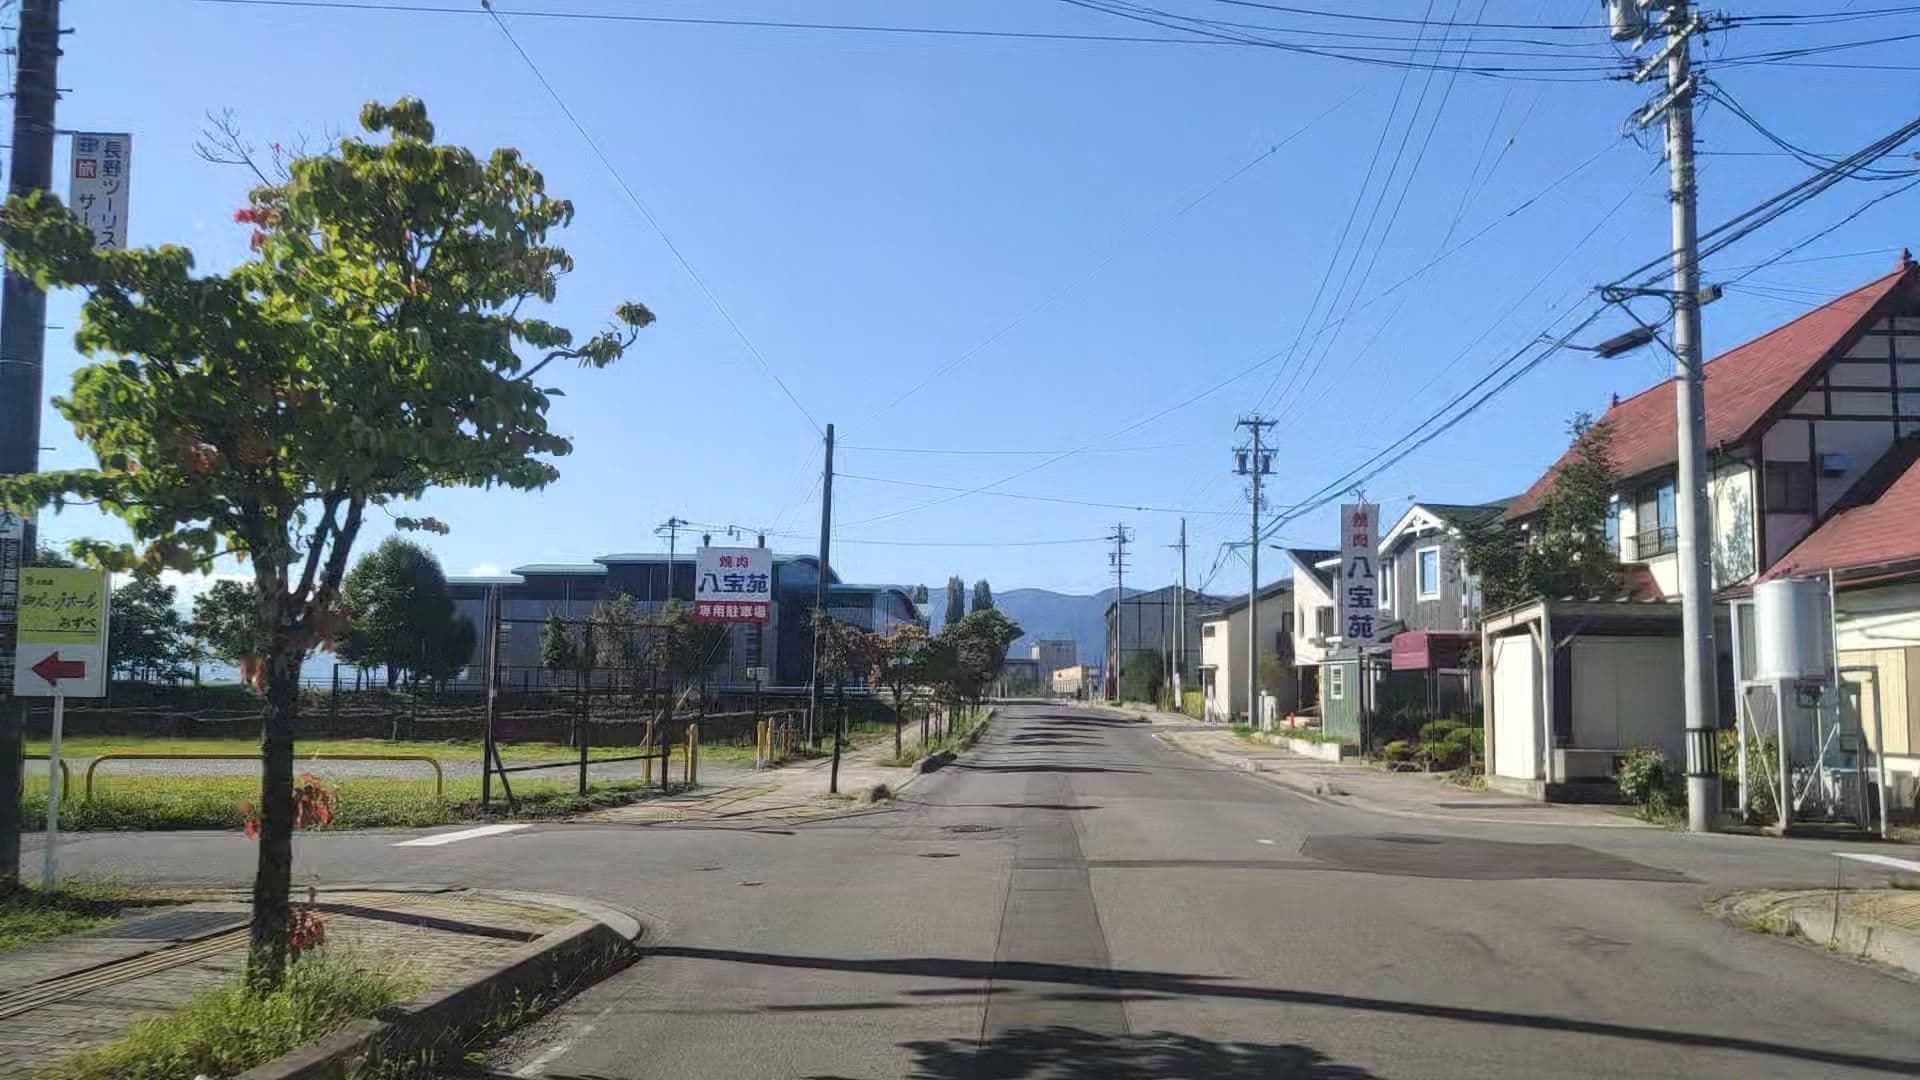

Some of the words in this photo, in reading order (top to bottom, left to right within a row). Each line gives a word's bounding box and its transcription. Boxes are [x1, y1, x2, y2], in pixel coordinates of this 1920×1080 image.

[98, 140, 122, 249] 長野ツーリス
[1351, 511, 1369, 548] 焼肉
[719, 554, 749, 569] 焼肉
[698, 572, 769, 594] 八宝苑
[1347, 555, 1375, 639] 八宝苑
[699, 604, 767, 618] 専用駐車場
